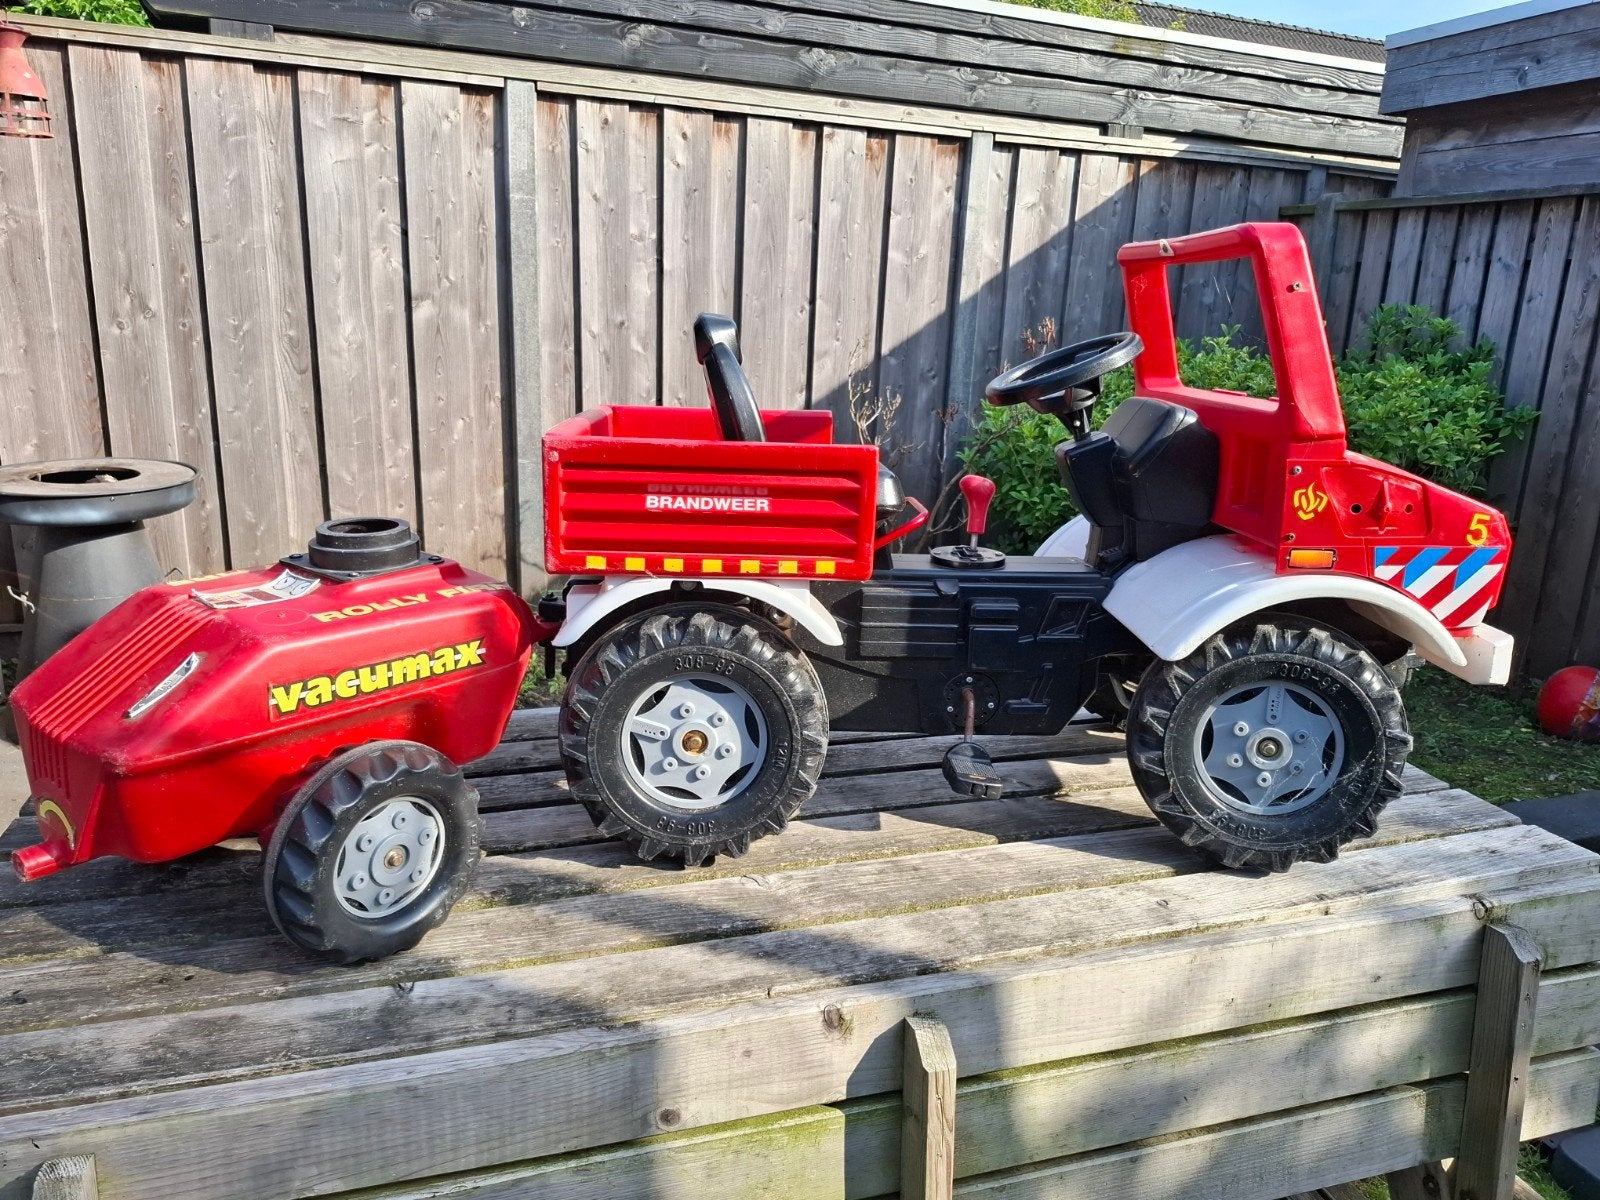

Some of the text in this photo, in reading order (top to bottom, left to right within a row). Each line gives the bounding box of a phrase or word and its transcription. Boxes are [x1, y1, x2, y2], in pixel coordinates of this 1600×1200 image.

[645, 495, 770, 512] BRANDWEER
[1466, 513, 1492, 546] 5
[312, 593, 430, 624] ROLLY
[270, 639, 485, 714] vacumax
